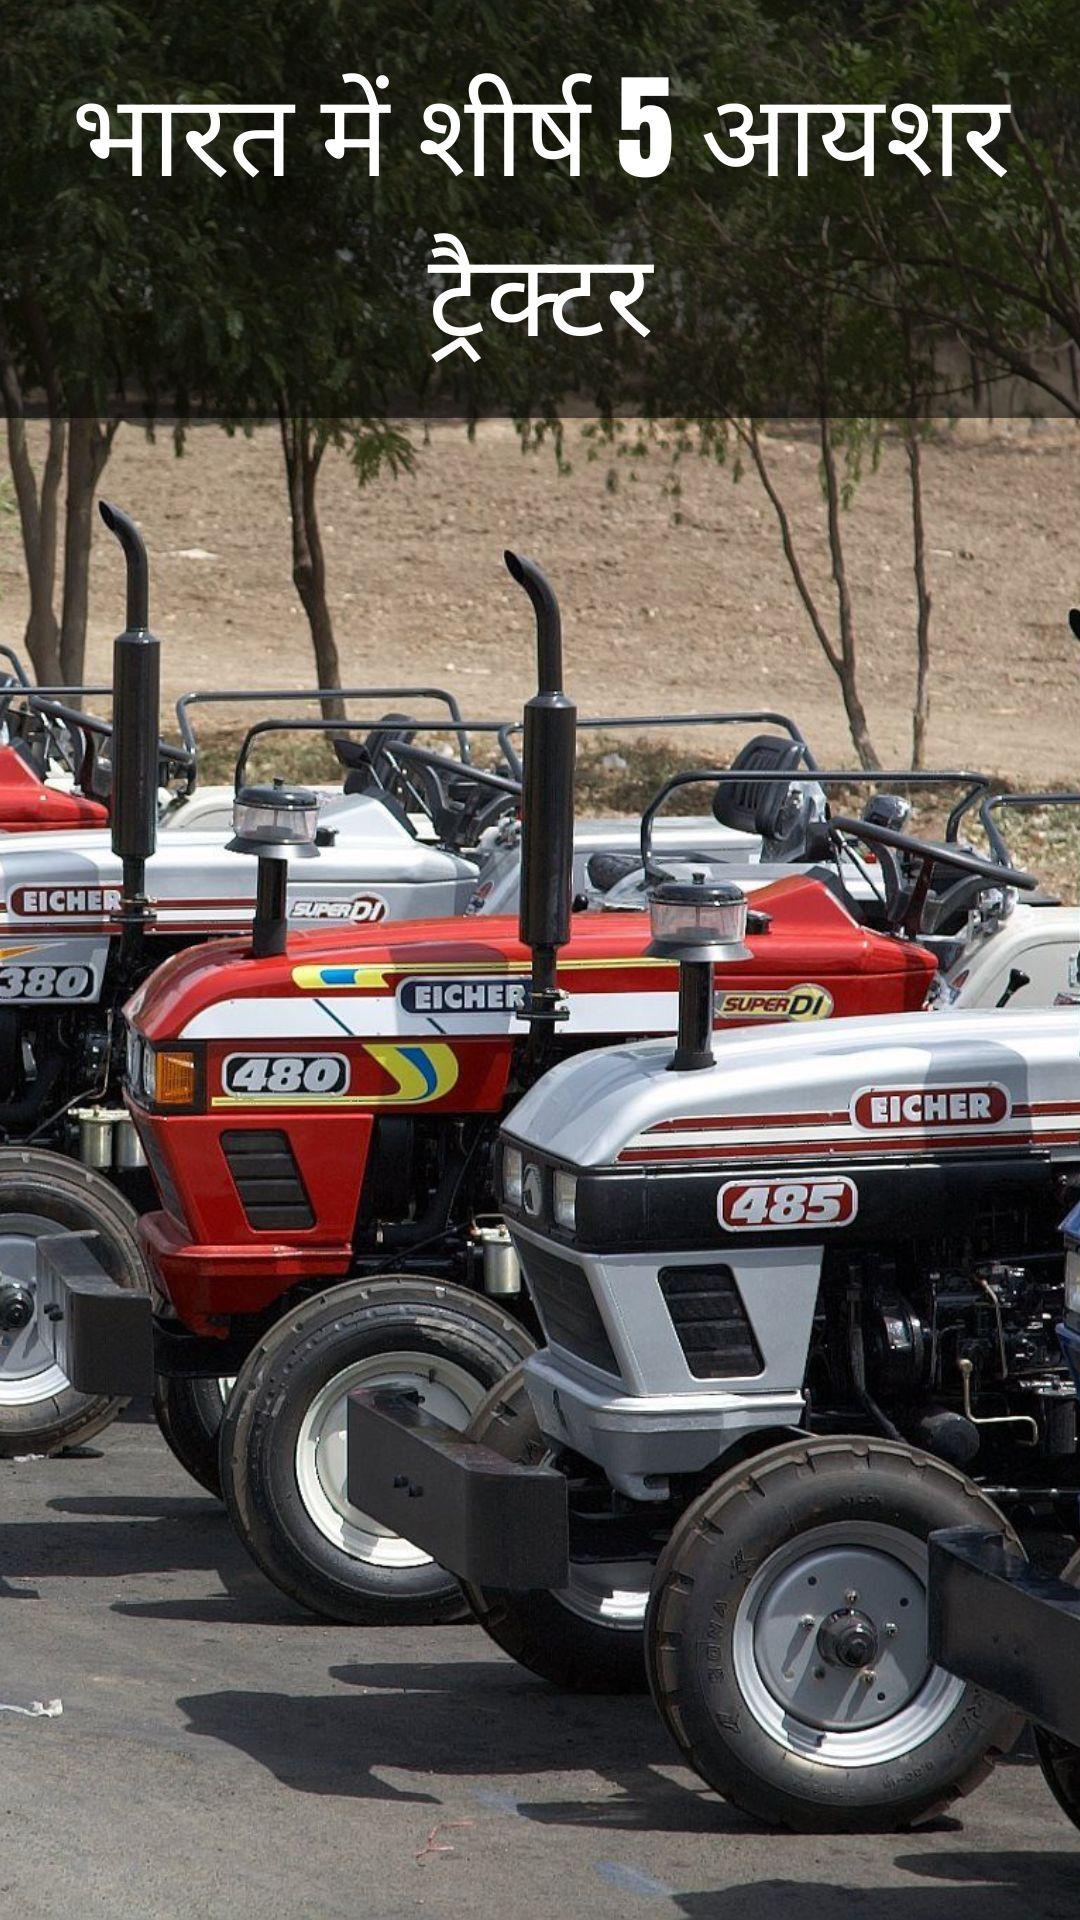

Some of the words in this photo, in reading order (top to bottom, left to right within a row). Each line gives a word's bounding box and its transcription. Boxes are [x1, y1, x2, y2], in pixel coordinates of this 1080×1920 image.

[23, 890, 122, 912] EICHER
[0, 967, 89, 998] 380
[414, 984, 527, 1010] EICHER
[232, 1058, 340, 1091] 480
[870, 1092, 993, 1124] EICHER
[730, 1184, 844, 1224] 485
